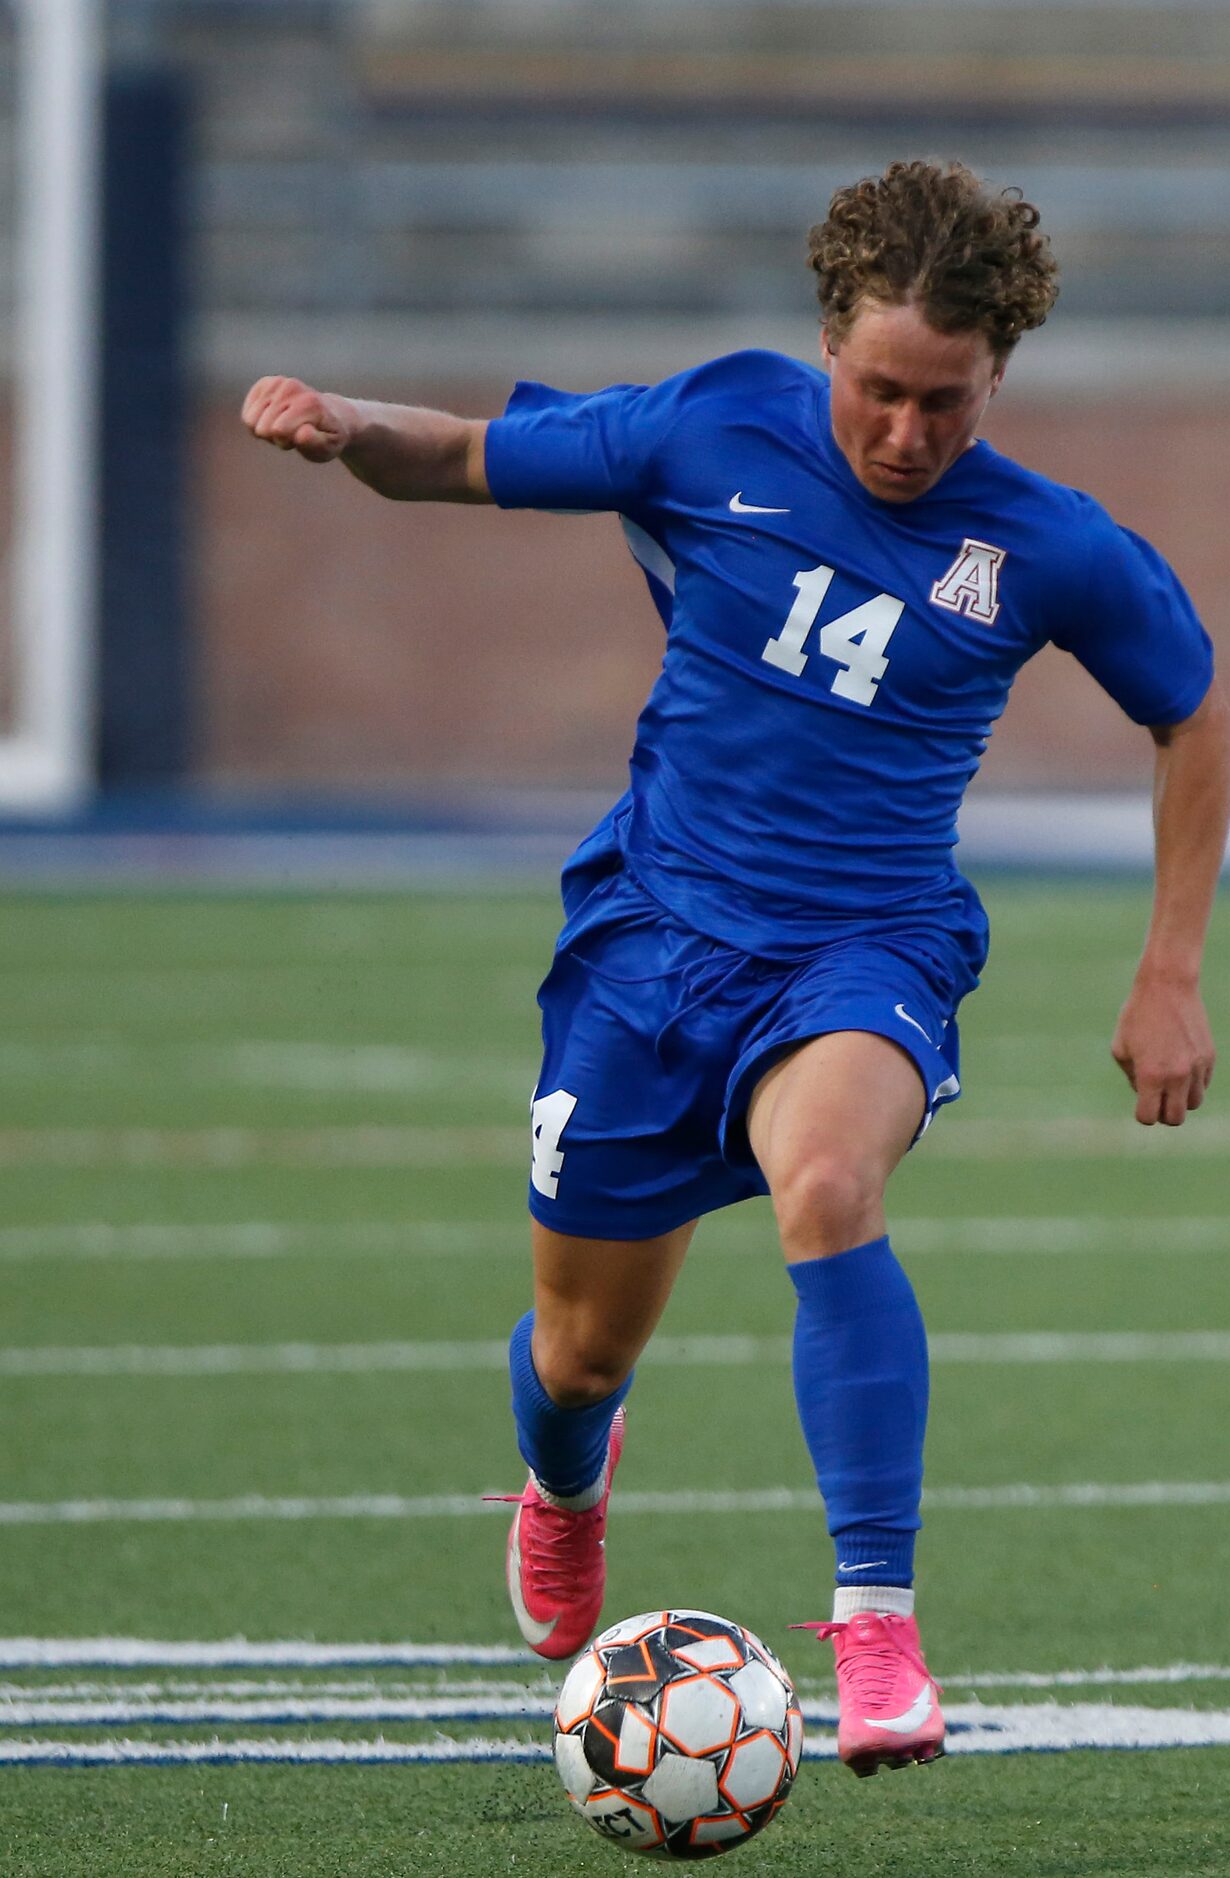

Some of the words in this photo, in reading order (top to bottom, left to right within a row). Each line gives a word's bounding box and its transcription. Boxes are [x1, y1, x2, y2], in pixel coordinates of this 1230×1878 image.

[761, 564, 906, 707] 14
[929, 538, 1007, 626] A
[530, 1083, 578, 1200] 4
